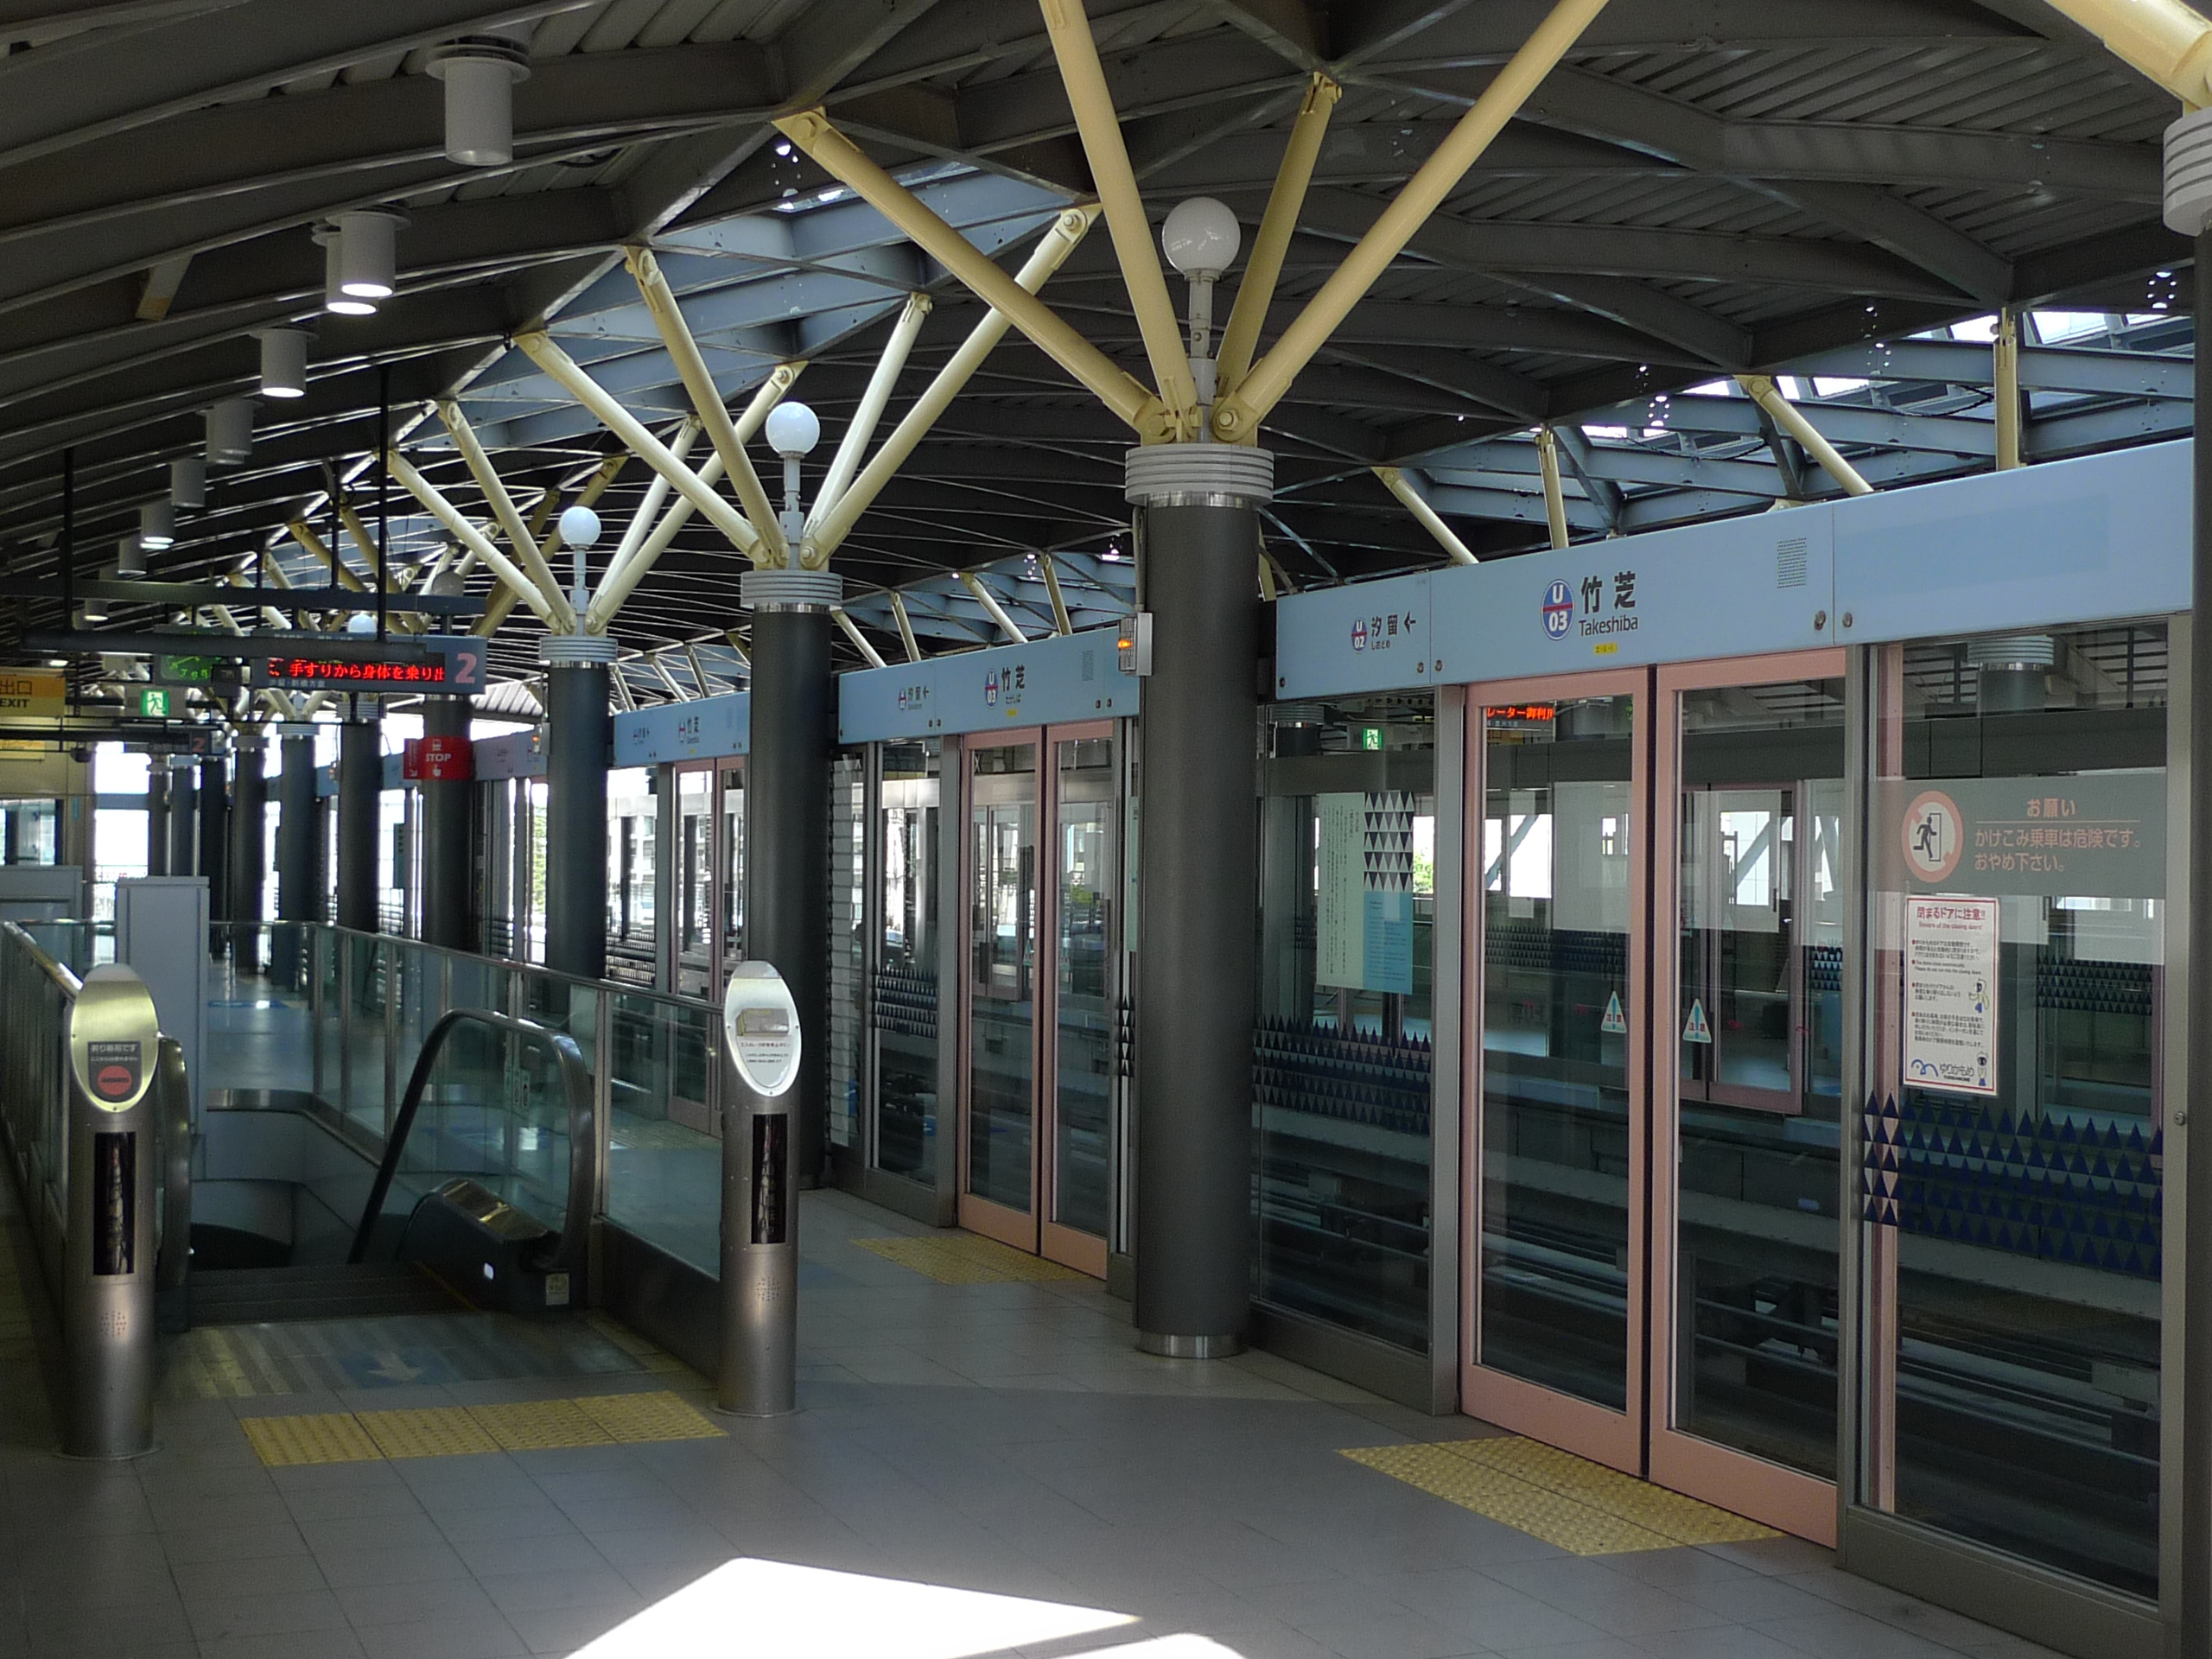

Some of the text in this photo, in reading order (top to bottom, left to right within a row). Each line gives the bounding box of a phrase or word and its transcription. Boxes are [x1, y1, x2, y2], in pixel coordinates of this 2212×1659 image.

[1553, 584, 1564, 604] U
[1580, 570, 1636, 614] 竹芝
[1371, 614, 1398, 637] 汐留
[1548, 610, 1568, 632] 03
[1579, 614, 1638, 637] Takeshiba
[1354, 636, 1364, 649] 02
[454, 652, 478, 683] 2
[0, 678, 33, 696] 出口
[1001, 664, 1026, 692] 竹芝
[0, 699, 29, 708] EXIT
[425, 753, 452, 762] STOP
[2027, 798, 2076, 818] お願い
[1974, 828, 2141, 849] かけこみ乗車は危険です。
[1974, 852, 2064, 872] おやめ下さい。
